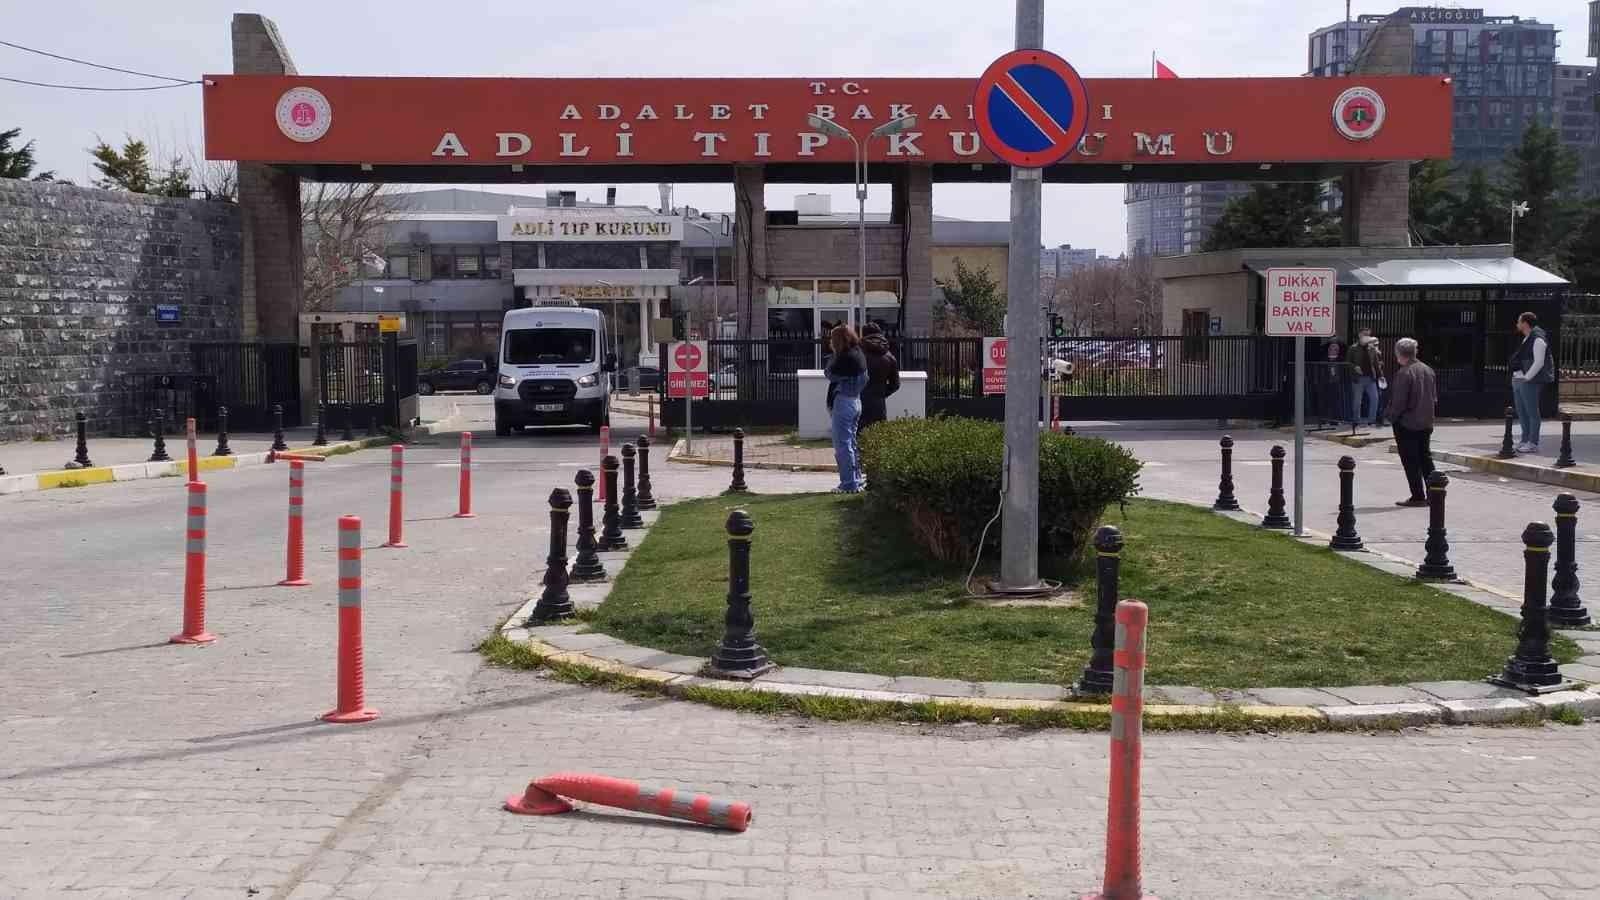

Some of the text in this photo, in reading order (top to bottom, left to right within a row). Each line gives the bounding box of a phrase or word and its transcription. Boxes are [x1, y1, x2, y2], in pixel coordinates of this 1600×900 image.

[809, 81, 870, 95] T.C.
[559, 104, 1113, 120] ADALET BAKAI
[431, 122, 1234, 157] ADLİ TIP KUUMU
[511, 219, 672, 236] ADLİ TIP KURUMU
[1278, 274, 1327, 288] DİKKAT
[1283, 291, 1320, 302] BLOK
[1287, 321, 1313, 333] VAR
[992, 347, 1006, 358] DU
[670, 378, 706, 389] GİRİMEZ
